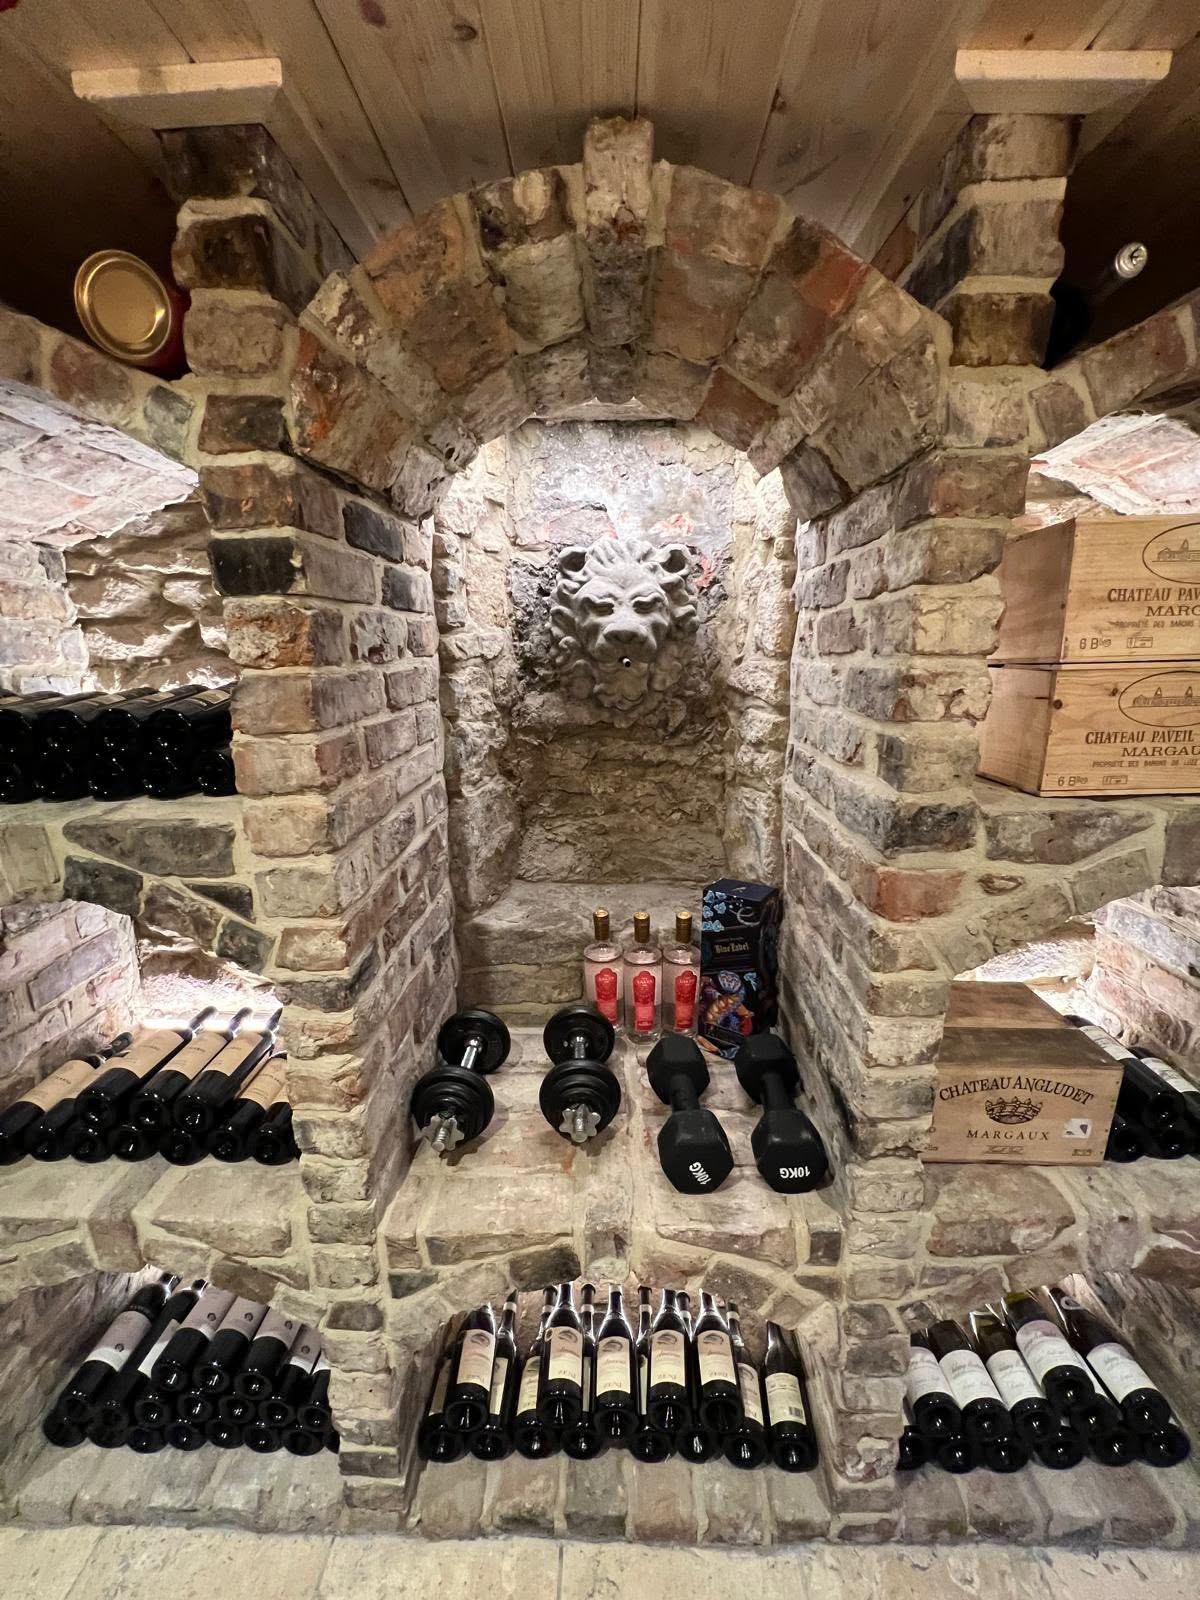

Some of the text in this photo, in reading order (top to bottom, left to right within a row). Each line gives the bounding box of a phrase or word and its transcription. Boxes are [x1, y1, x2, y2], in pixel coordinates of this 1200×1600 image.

[1107, 587, 1172, 602] CHATEAU
[1085, 729, 1194, 744] CHATEAU PAVEIL
[939, 1075, 1094, 1105] CHATEAU ANGLUDET
[966, 1129, 1050, 1141] MARGAUX
[688, 1161, 712, 1185] 10KG
[779, 1165, 811, 1179] 10KG
